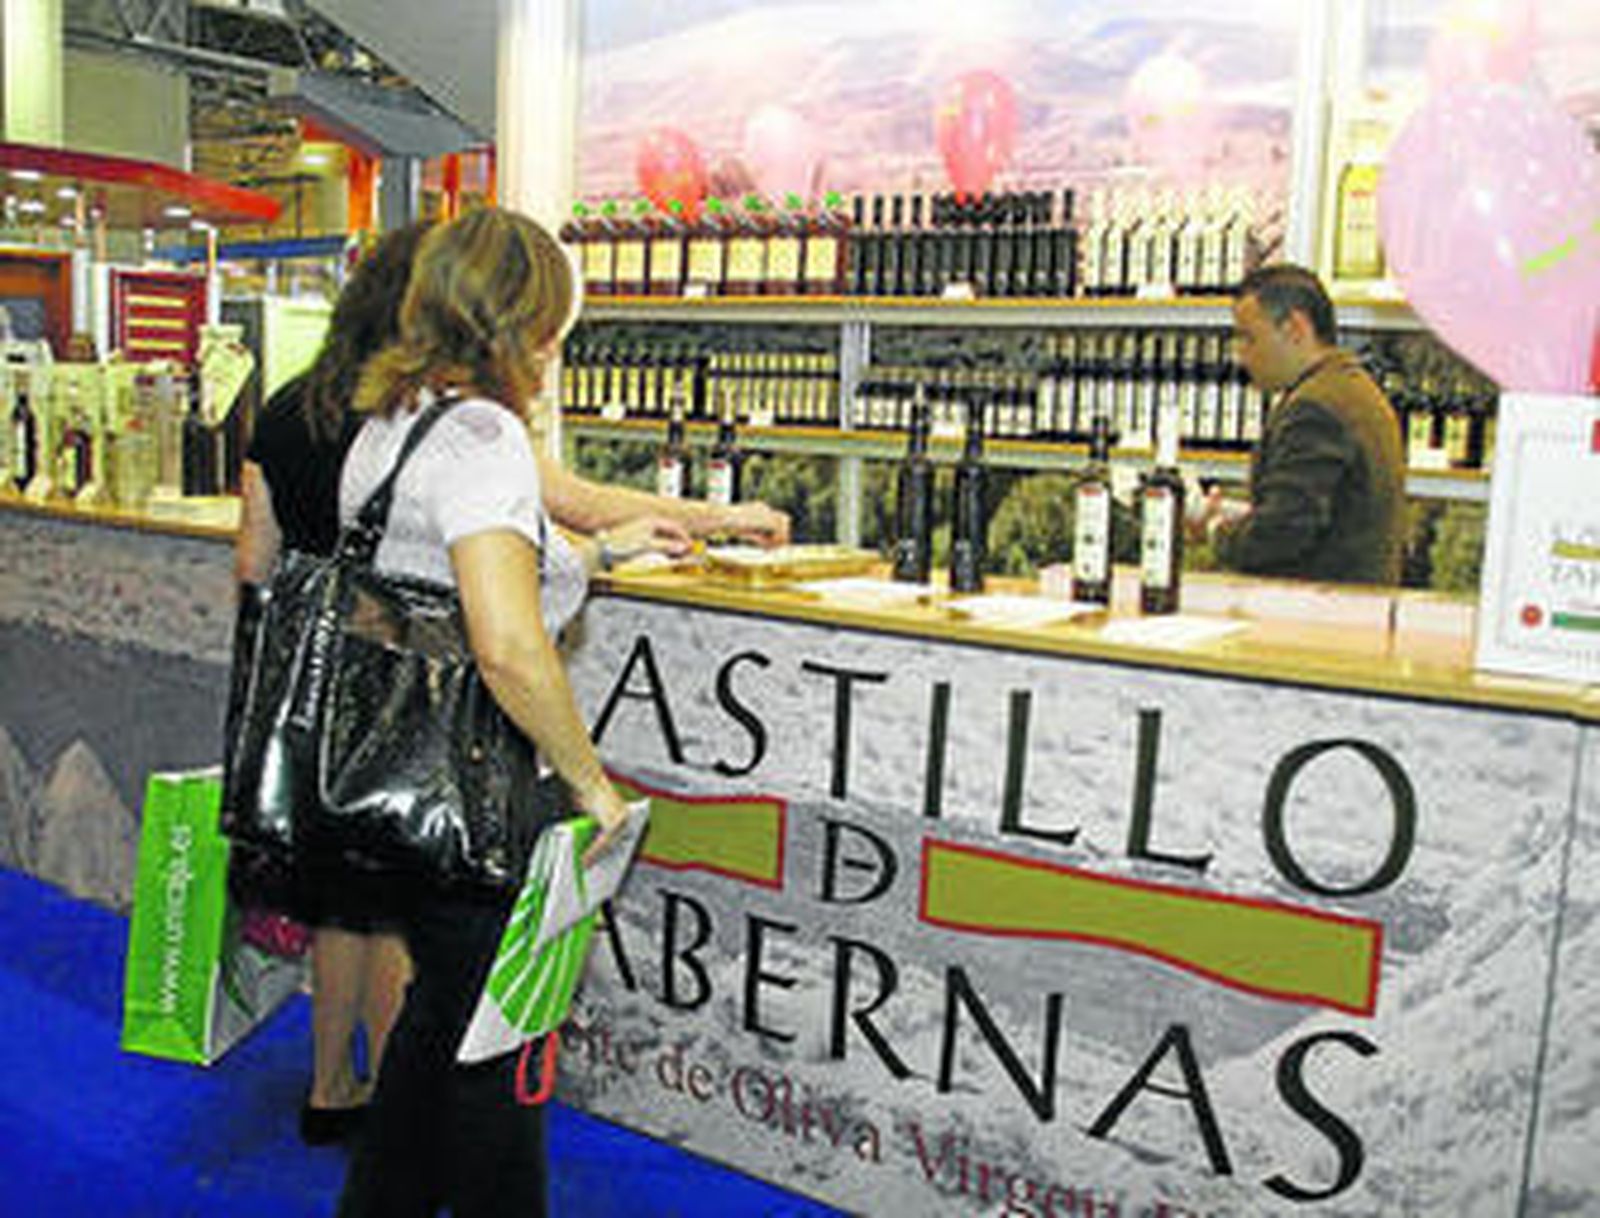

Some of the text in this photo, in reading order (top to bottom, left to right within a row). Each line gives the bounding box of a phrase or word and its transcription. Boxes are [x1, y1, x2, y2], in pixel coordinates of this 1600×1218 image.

[591, 633, 1418, 898] ASTILLO
[657, 1043, 713, 1102] de
[731, 1065, 882, 1164] Oliva
